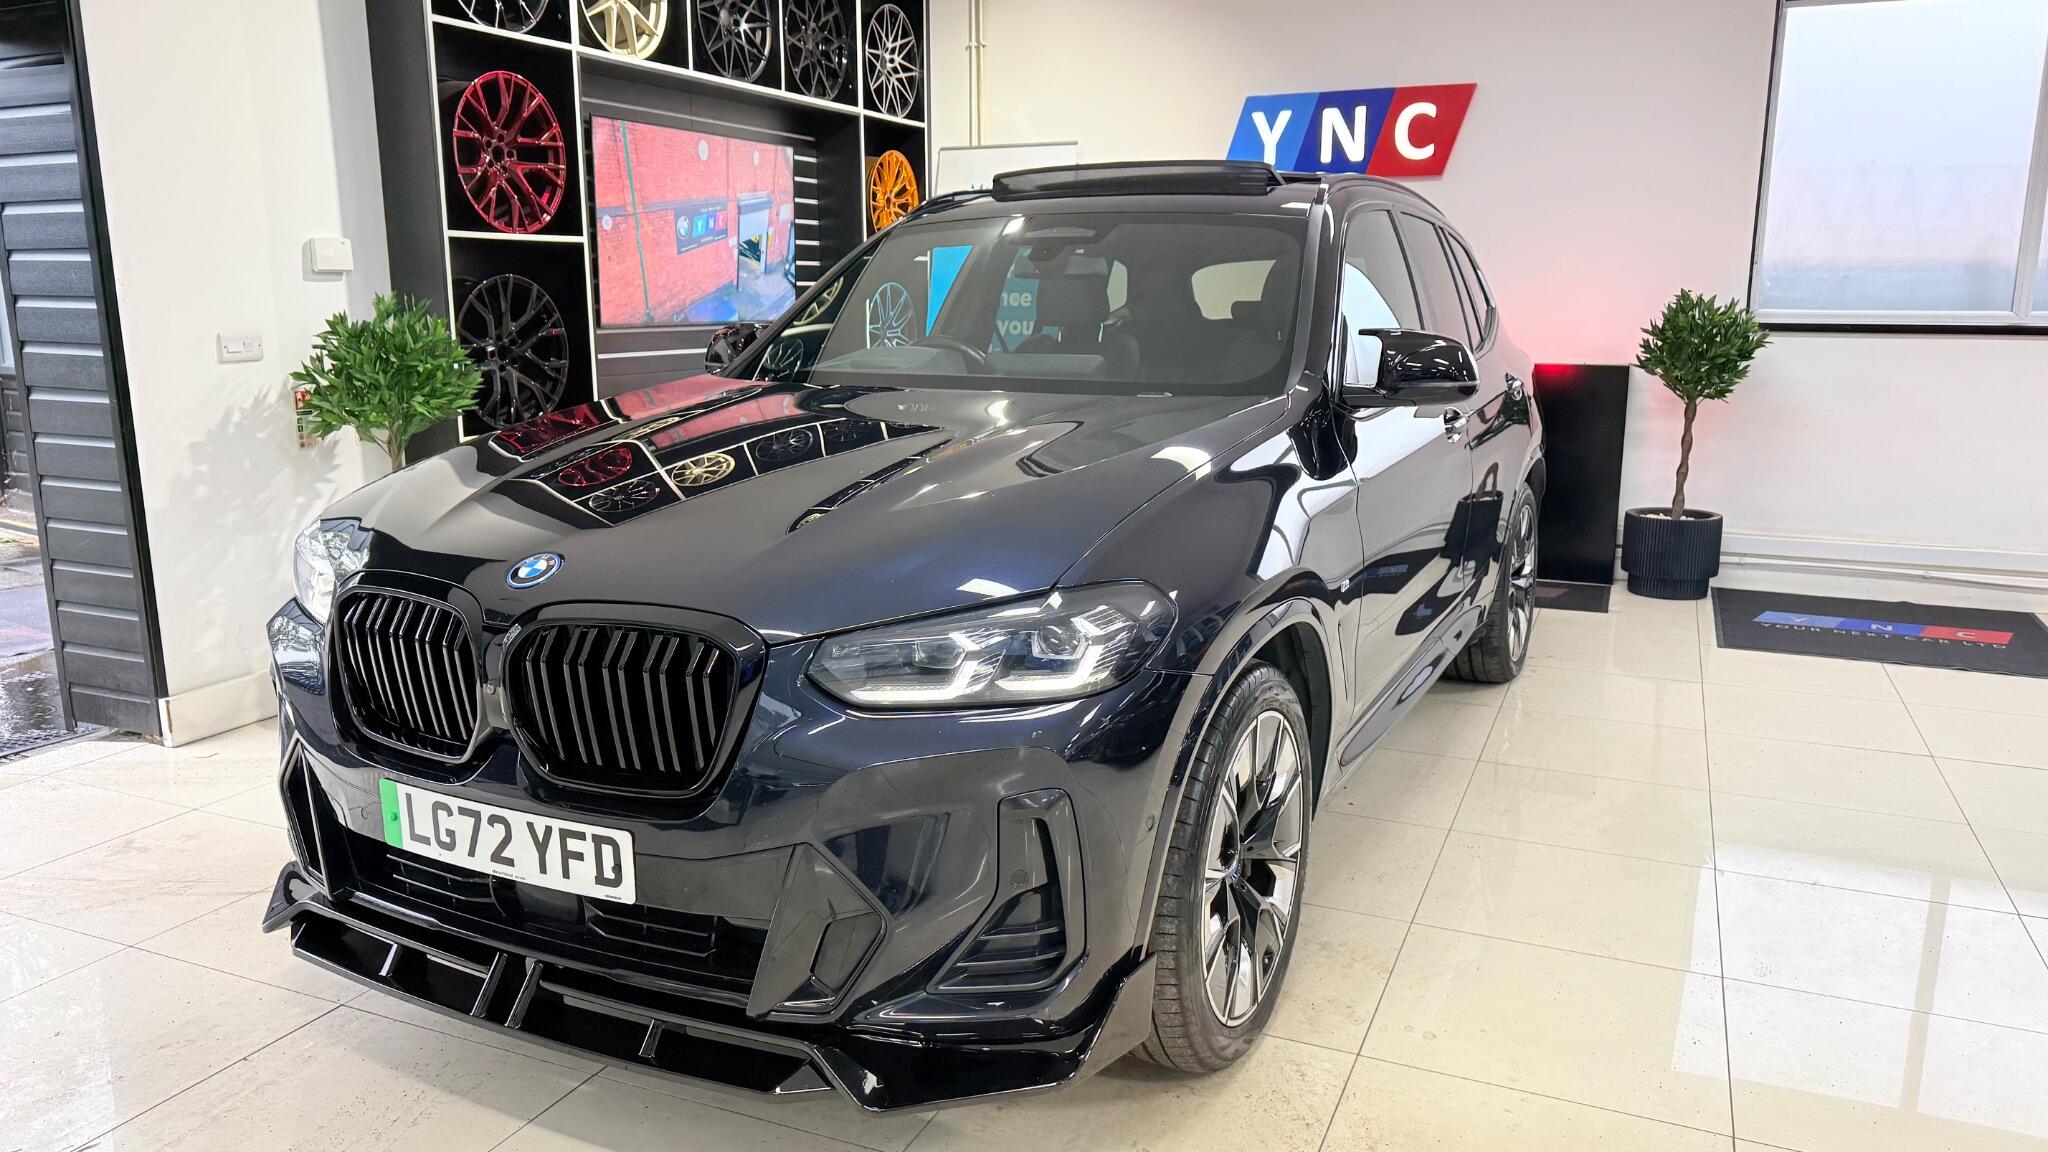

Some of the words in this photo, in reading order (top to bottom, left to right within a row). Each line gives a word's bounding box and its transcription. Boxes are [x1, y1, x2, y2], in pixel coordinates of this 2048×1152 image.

[1252, 101, 1437, 165] YNC
[1761, 622, 1820, 632] YOUR
[1904, 636, 1951, 645] CAR
[1962, 640, 2006, 649] LTD
[405, 792, 515, 868] LG72
[526, 821, 623, 888] YFD
